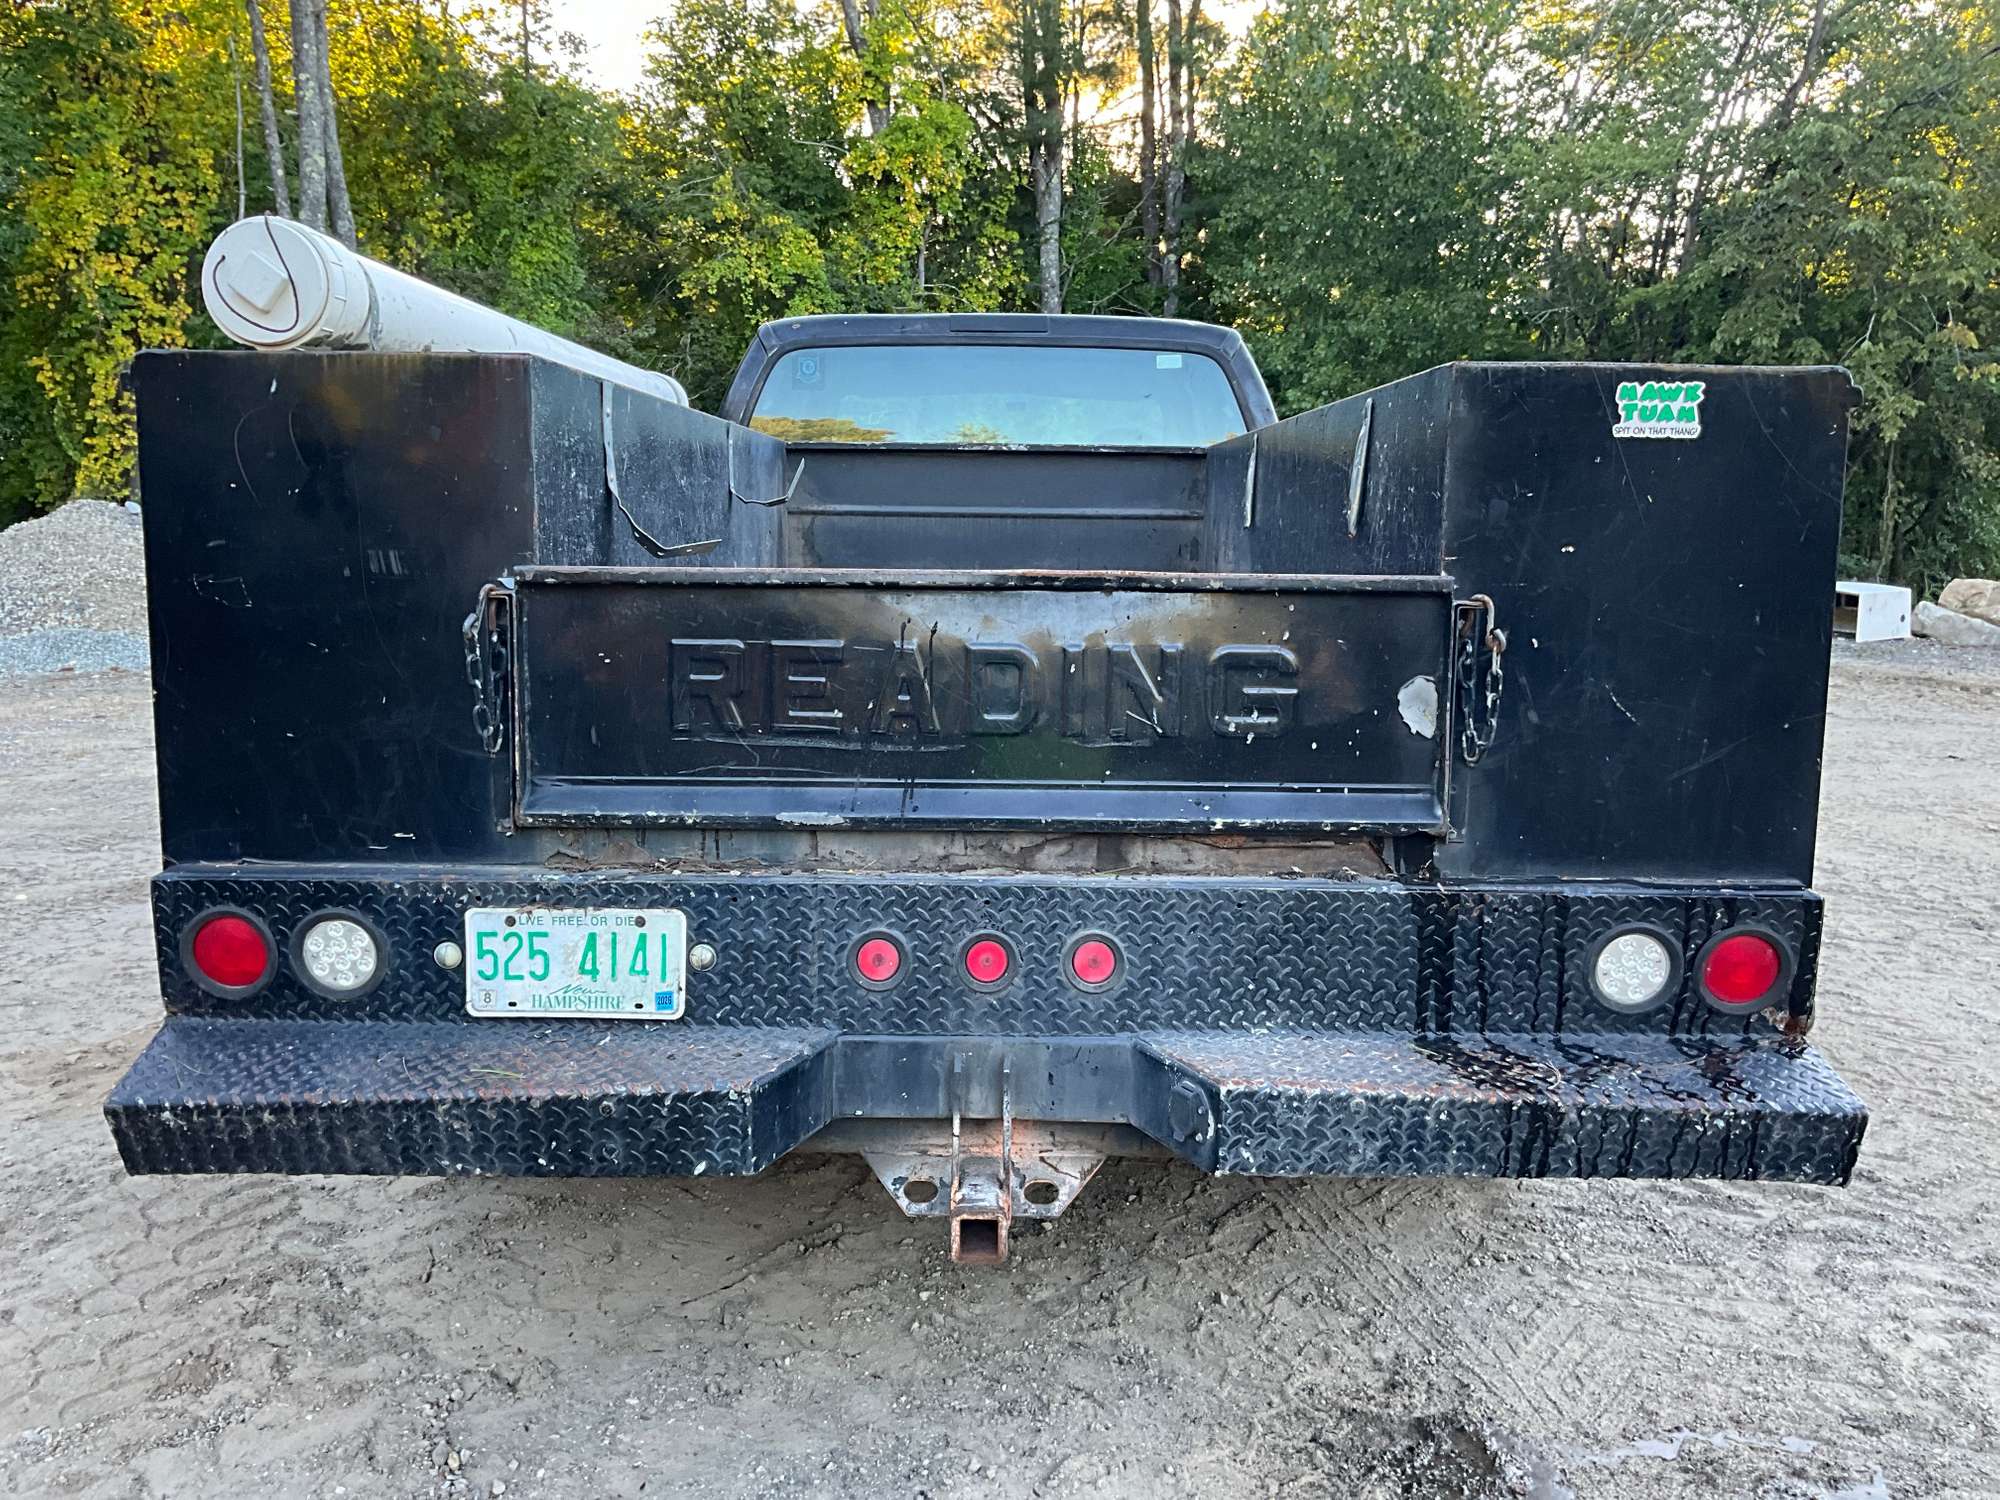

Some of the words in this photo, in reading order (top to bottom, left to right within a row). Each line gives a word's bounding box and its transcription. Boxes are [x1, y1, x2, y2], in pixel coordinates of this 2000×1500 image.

[1619, 383, 1702, 402] HAWK
[1622, 403, 1696, 422] TUAH
[1614, 427, 1631, 435] SPIT
[1633, 427, 1646, 435] ON
[1649, 427, 1668, 436] THAT
[669, 638, 1298, 739] READING
[519, 916, 543, 926] LIVE
[552, 916, 583, 926] FREE
[591, 916, 607, 926] OR
[616, 916, 635, 926] DIE
[476, 931, 550, 981] 525
[578, 931, 667, 983] 4141
[483, 992, 492, 1004] 8
[531, 994, 624, 1010] HAMPSHIRE
